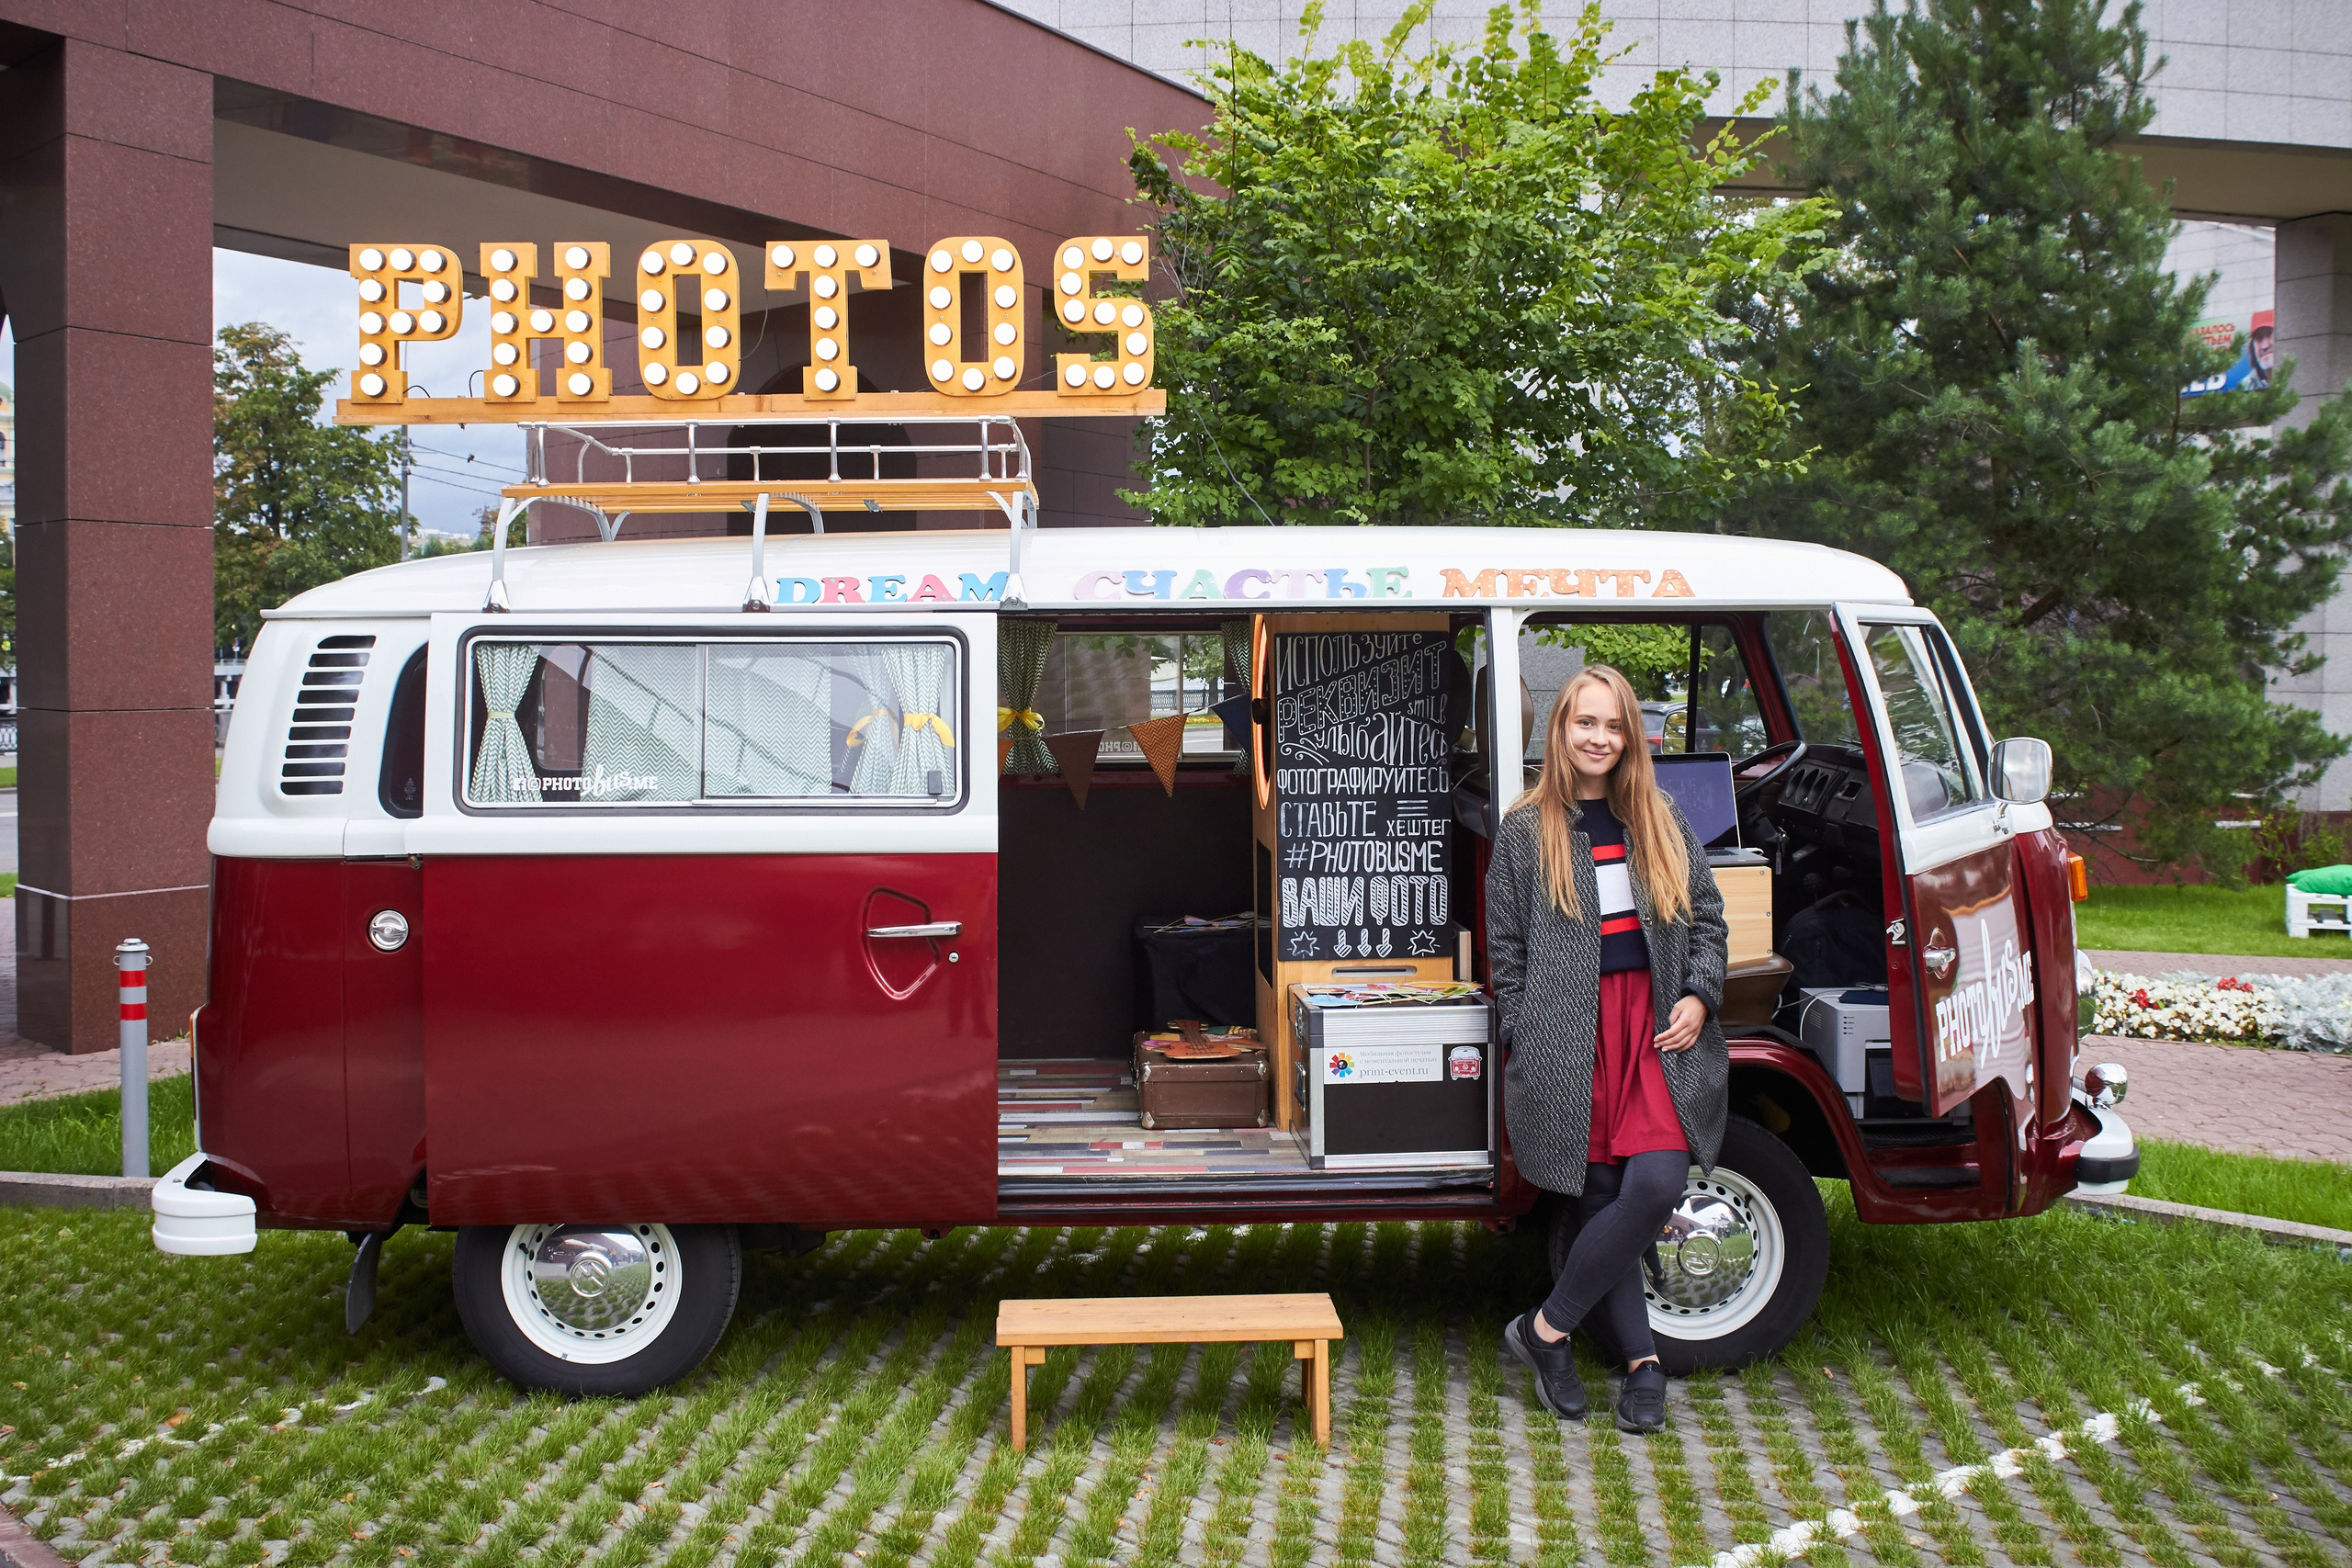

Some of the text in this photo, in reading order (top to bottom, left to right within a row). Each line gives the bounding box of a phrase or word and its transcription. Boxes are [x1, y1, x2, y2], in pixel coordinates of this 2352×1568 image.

[349, 236, 1155, 404] PHOTOS
[774, 571, 1010, 604] DREAM
[1074, 566, 1697, 601] СЧАСТЬЕ МЕЧТА
[1277, 640, 1447, 743] РЕКВИЗИТ
[1276, 766, 1450, 795] ФОТОГРАФИРУЙТЕСЬ
[1280, 800, 1452, 838] СТАВЬТЕ ХЕШТЕГ
[1283, 840, 1443, 874] #PHOTOBUSME
[1282, 874, 1448, 928] ВАШИ ФОТО
[1360, 1067, 1430, 1078] print-event.ru
